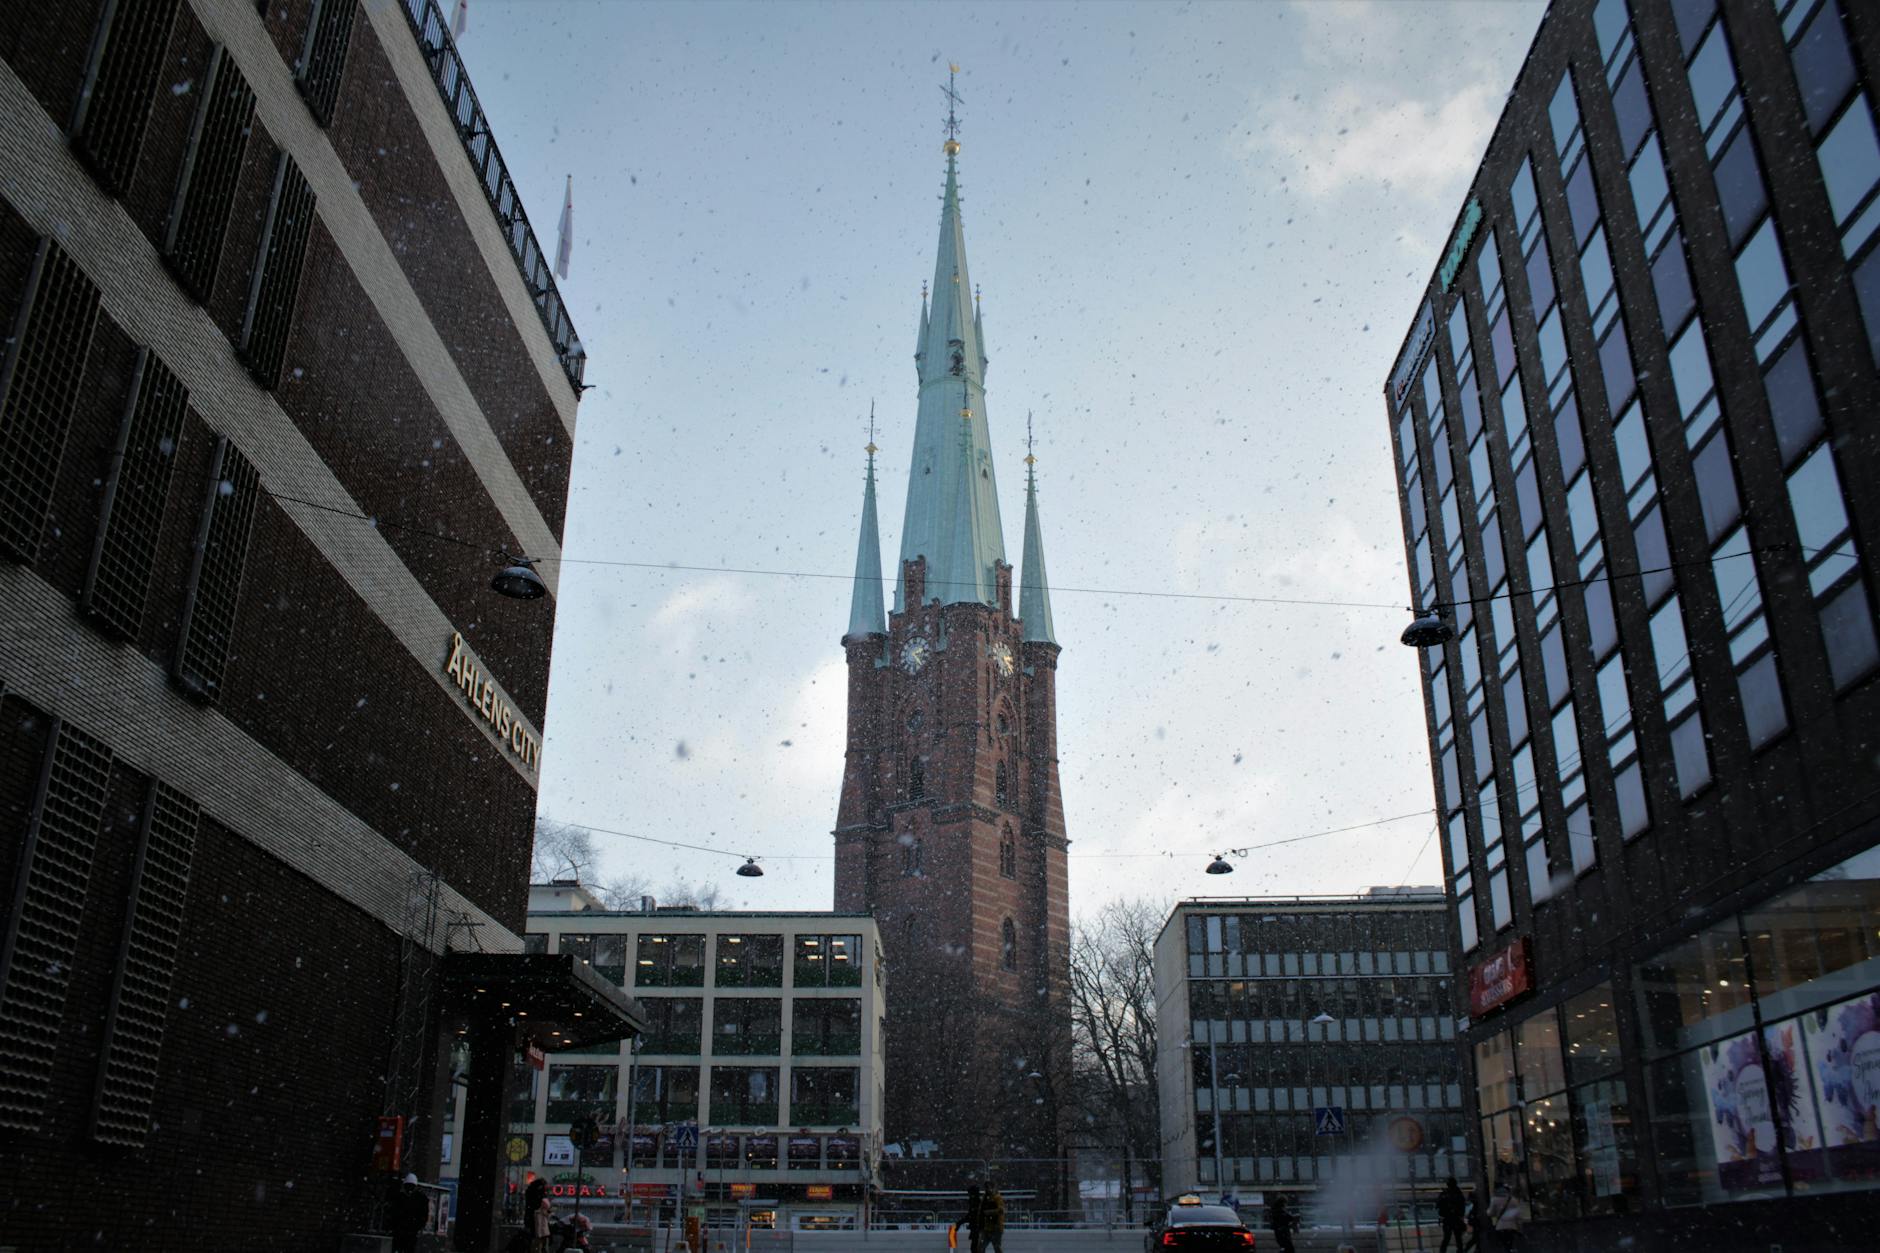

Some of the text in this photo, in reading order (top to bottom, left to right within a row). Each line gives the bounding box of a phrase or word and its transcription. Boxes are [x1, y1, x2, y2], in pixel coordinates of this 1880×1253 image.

[447, 631, 541, 773] ÅHLÉNS CITY
[545, 1184, 606, 1197] OBAK
